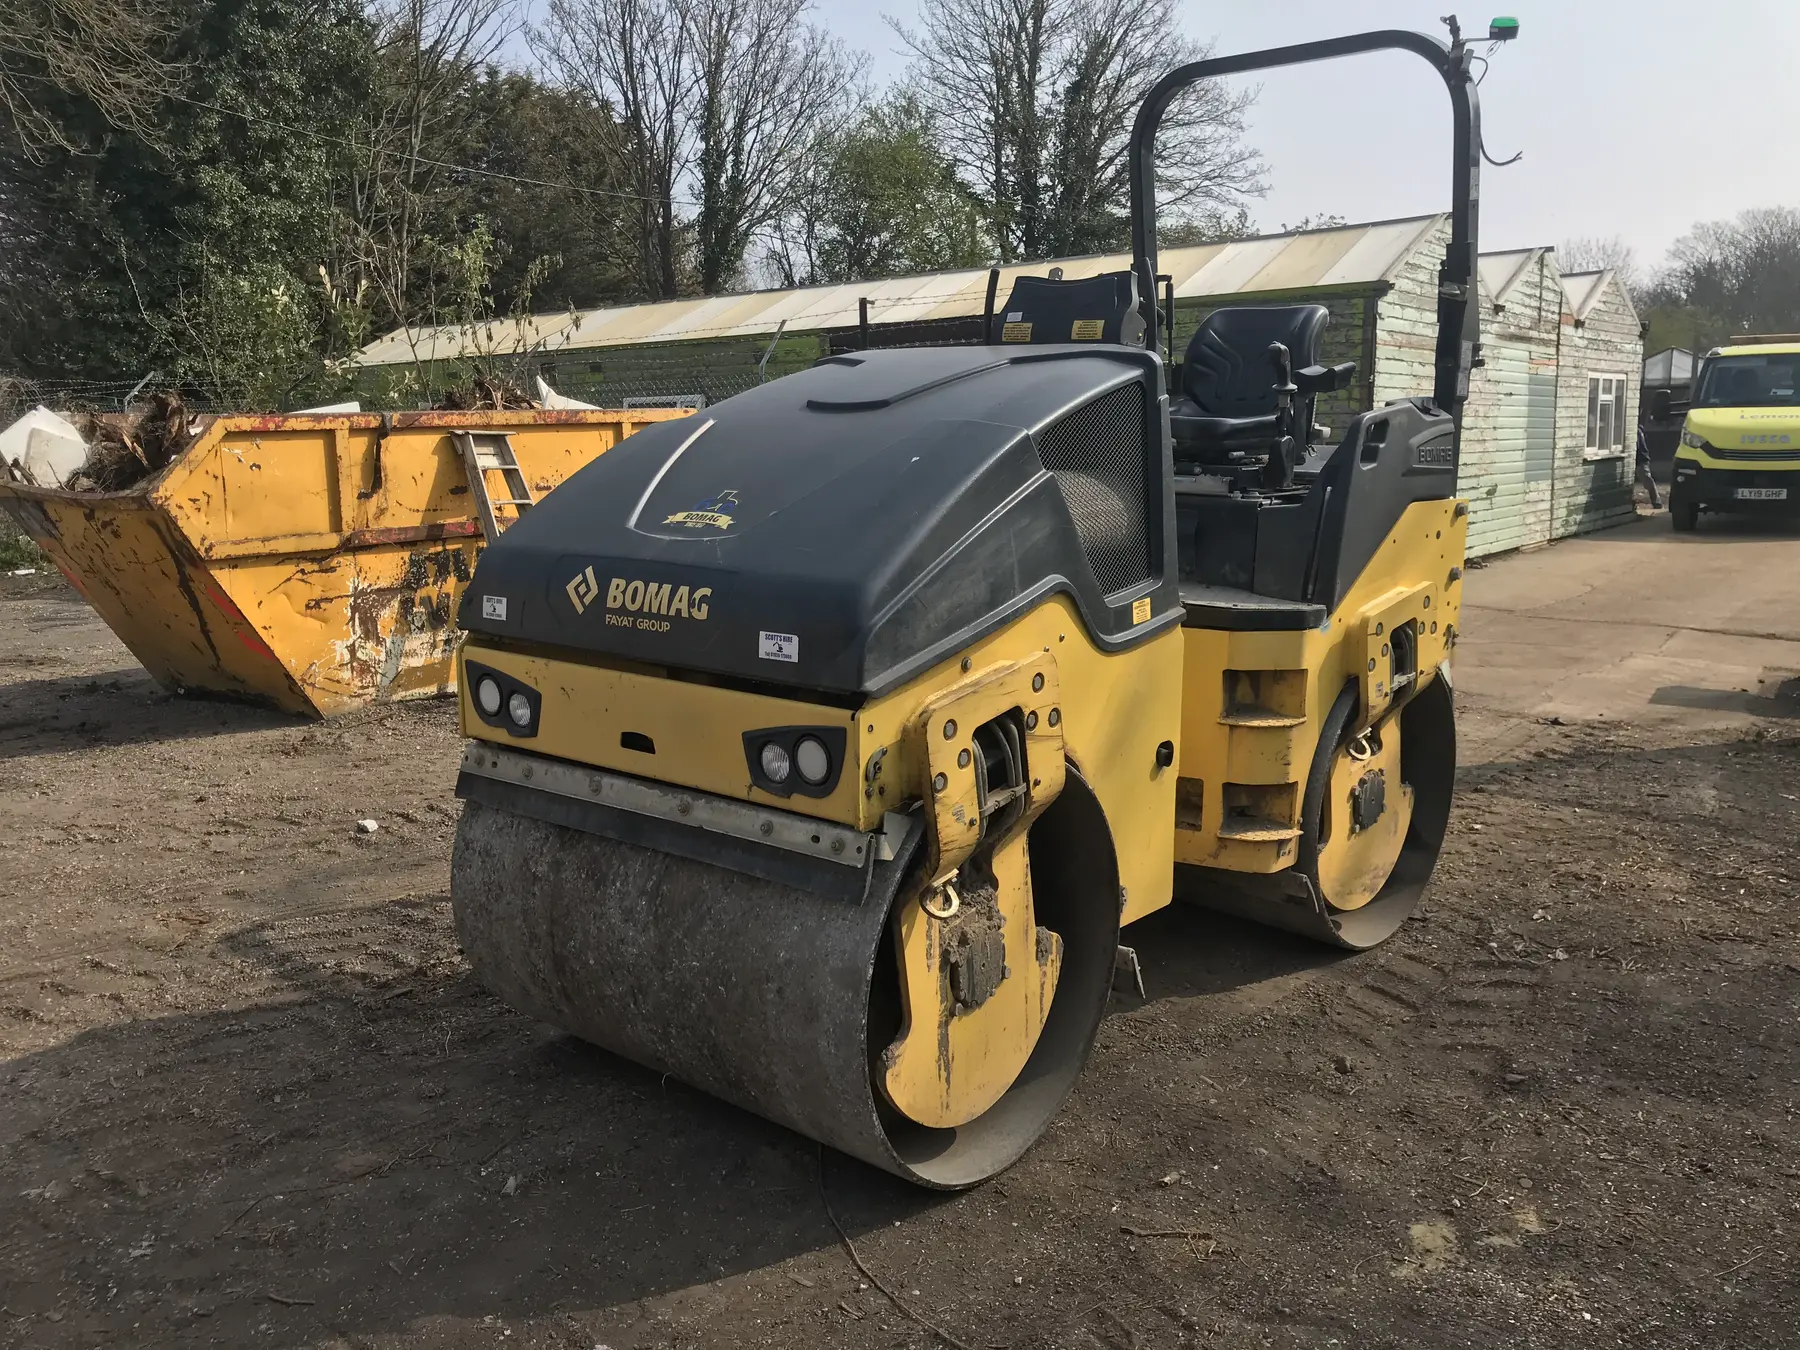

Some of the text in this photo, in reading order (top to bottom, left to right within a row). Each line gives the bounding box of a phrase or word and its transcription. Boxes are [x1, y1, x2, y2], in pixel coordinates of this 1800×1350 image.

[1740, 434, 1790, 444] IVECO
[1418, 446, 1452, 463] BOMAG
[1741, 489, 1784, 498] LY19 GHF
[683, 512, 722, 523] BOMAG
[606, 577, 713, 620] BOMAG
[605, 614, 671, 633] FAYAT GROUP
